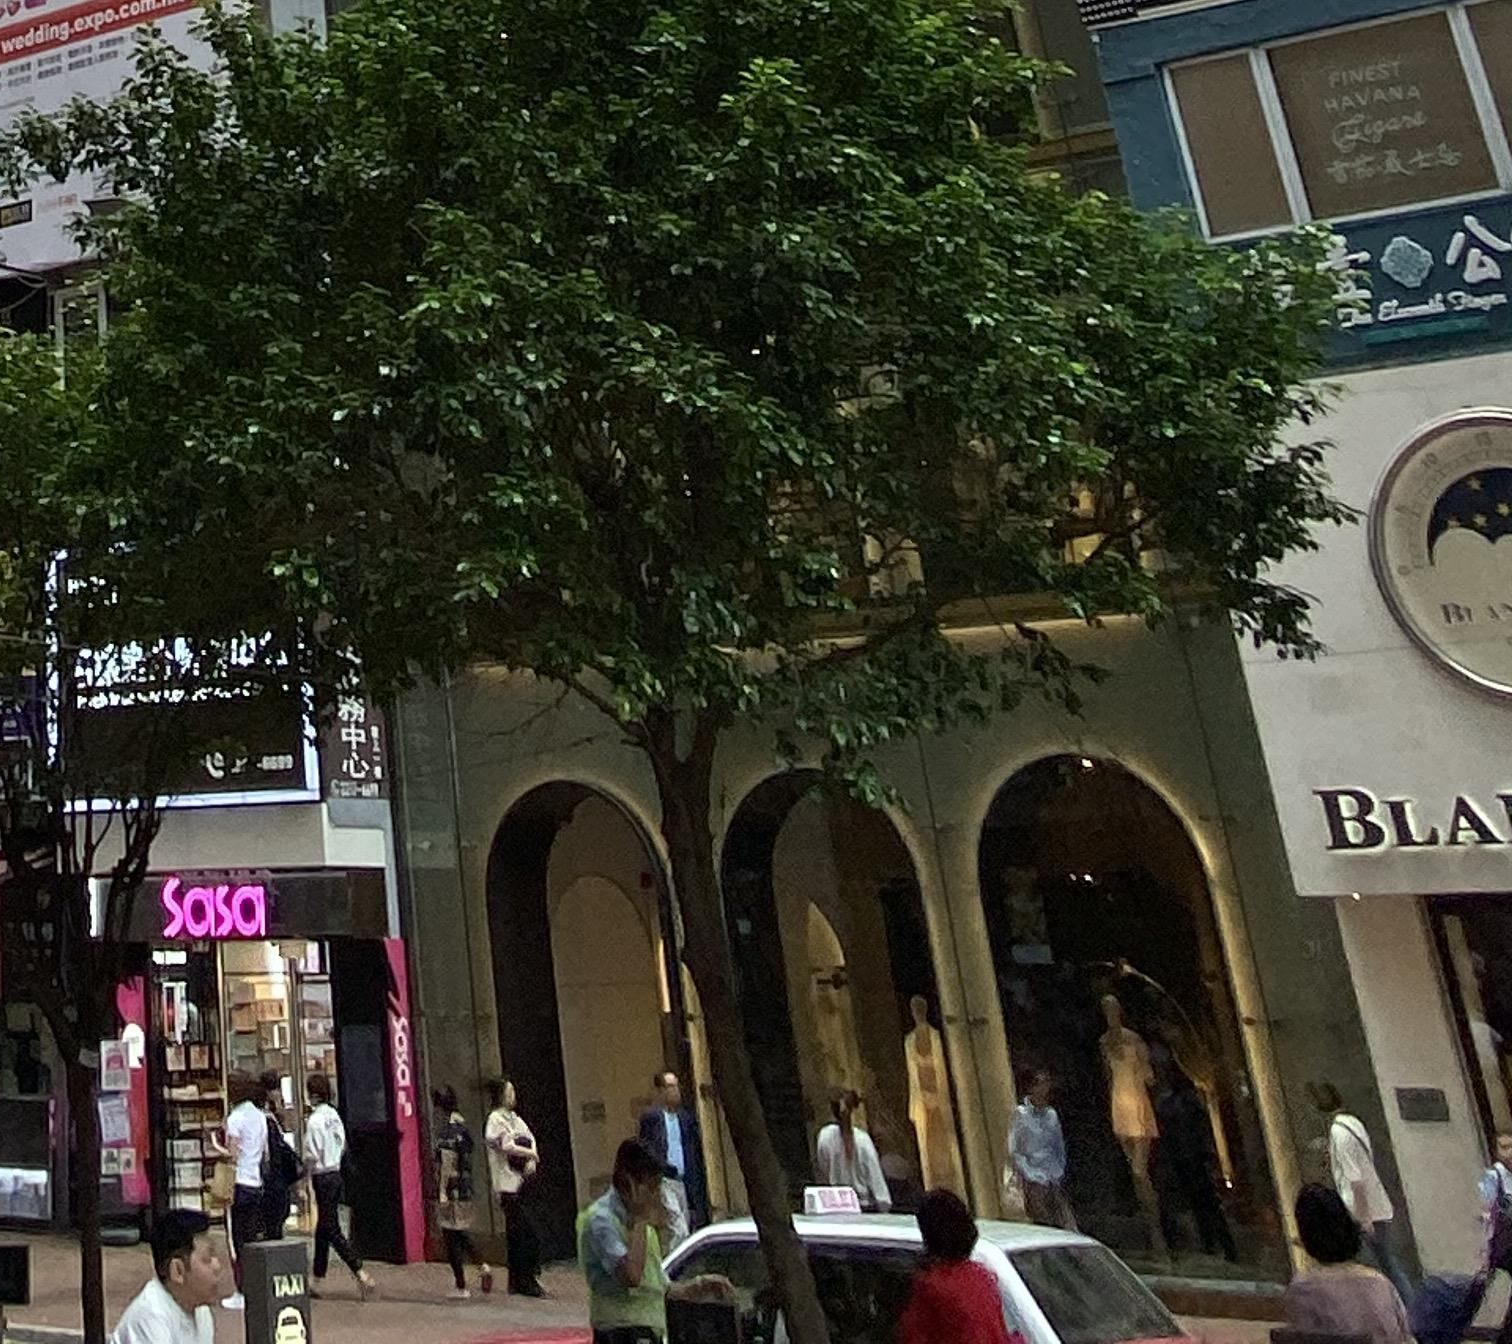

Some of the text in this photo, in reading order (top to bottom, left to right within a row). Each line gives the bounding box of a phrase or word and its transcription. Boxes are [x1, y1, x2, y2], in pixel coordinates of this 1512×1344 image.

[1328, 62, 1403, 89] FINEST
[1323, 85, 1422, 113] HAVANA
[273, 1273, 305, 1298] TAXI
